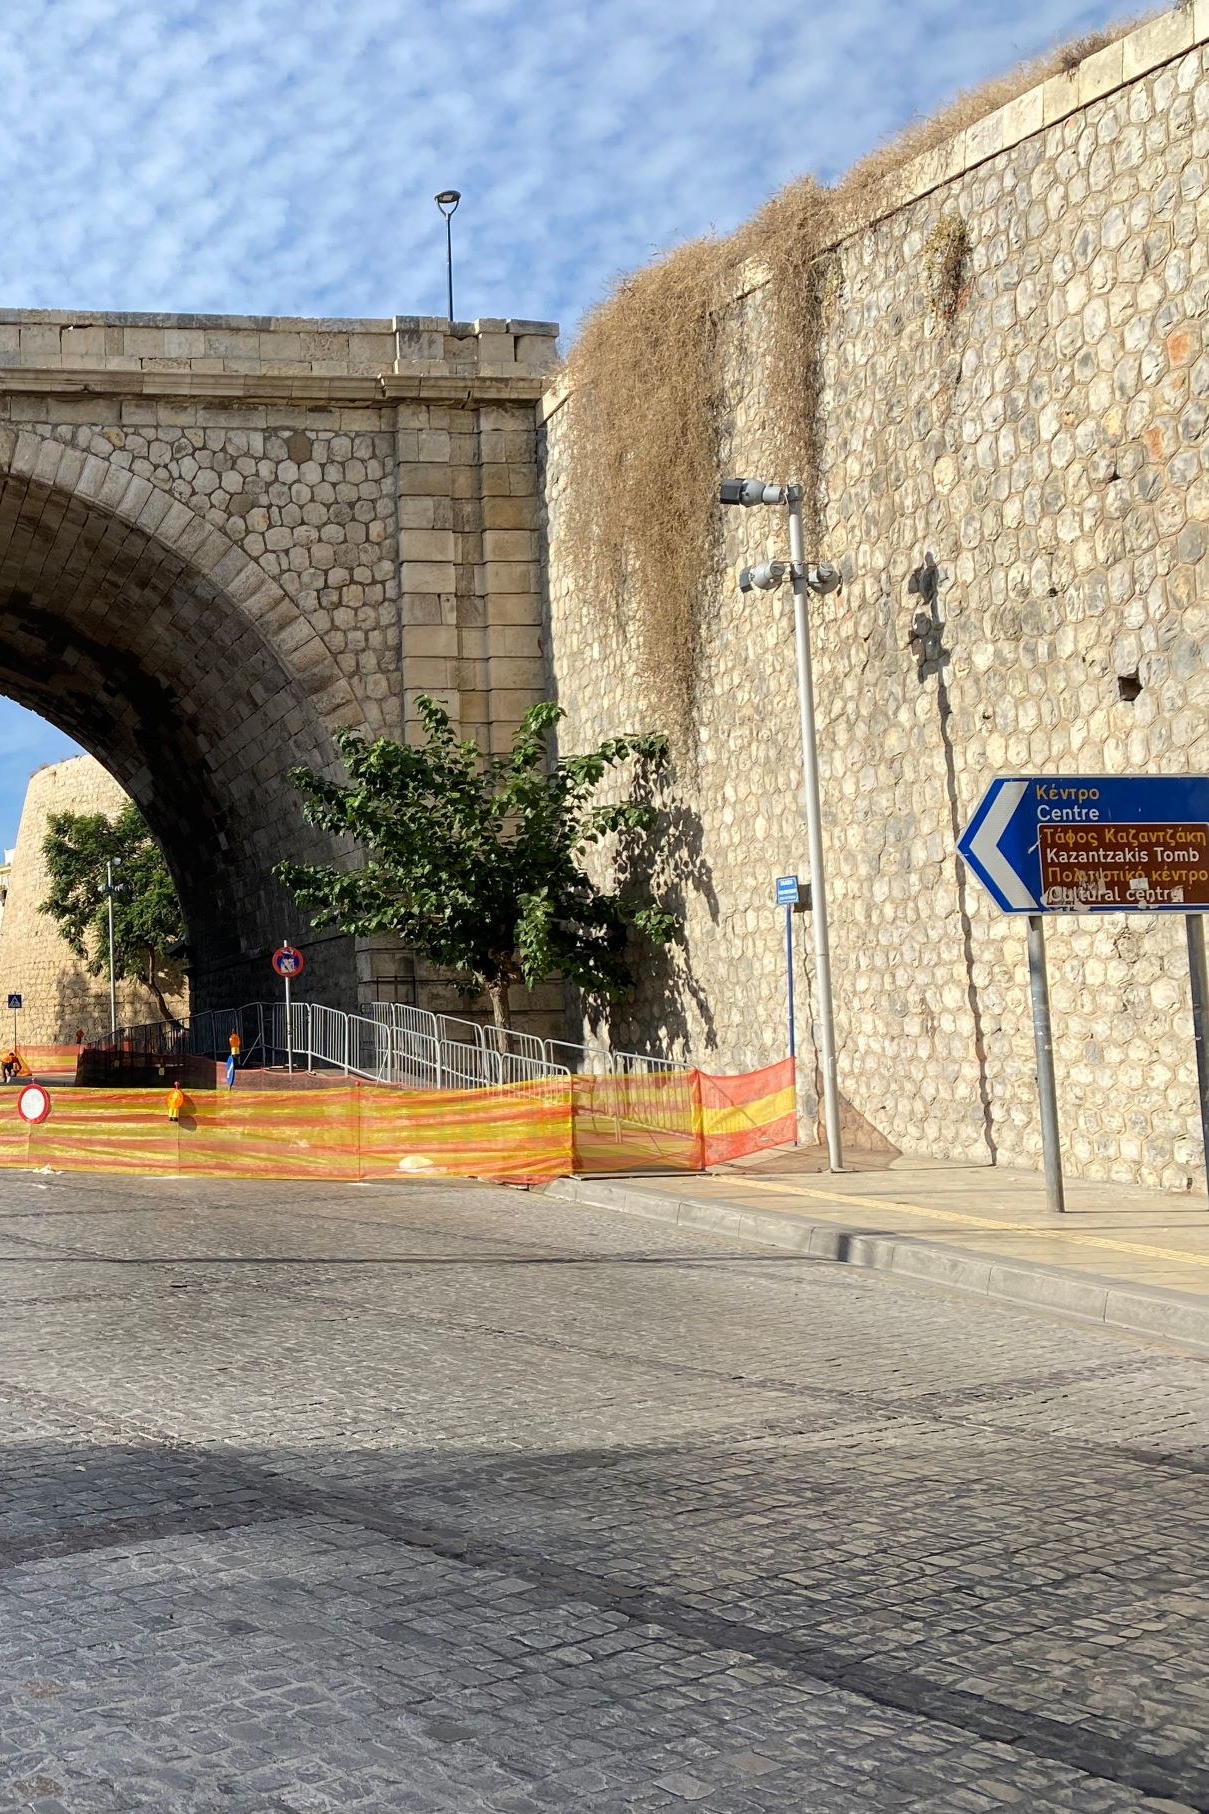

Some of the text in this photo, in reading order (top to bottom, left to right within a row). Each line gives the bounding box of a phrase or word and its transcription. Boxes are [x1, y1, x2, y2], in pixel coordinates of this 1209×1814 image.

[1036, 783, 1100, 804] Κέντρο
[1036, 804, 1100, 821] Centre
[1043, 827, 1207, 848] Τάφος Καζαντζάκη
[1046, 846, 1200, 864] Kazantzakis Tomb
[1151, 865, 1209, 885] κέντρο
[1048, 886, 1122, 902] Cultural
